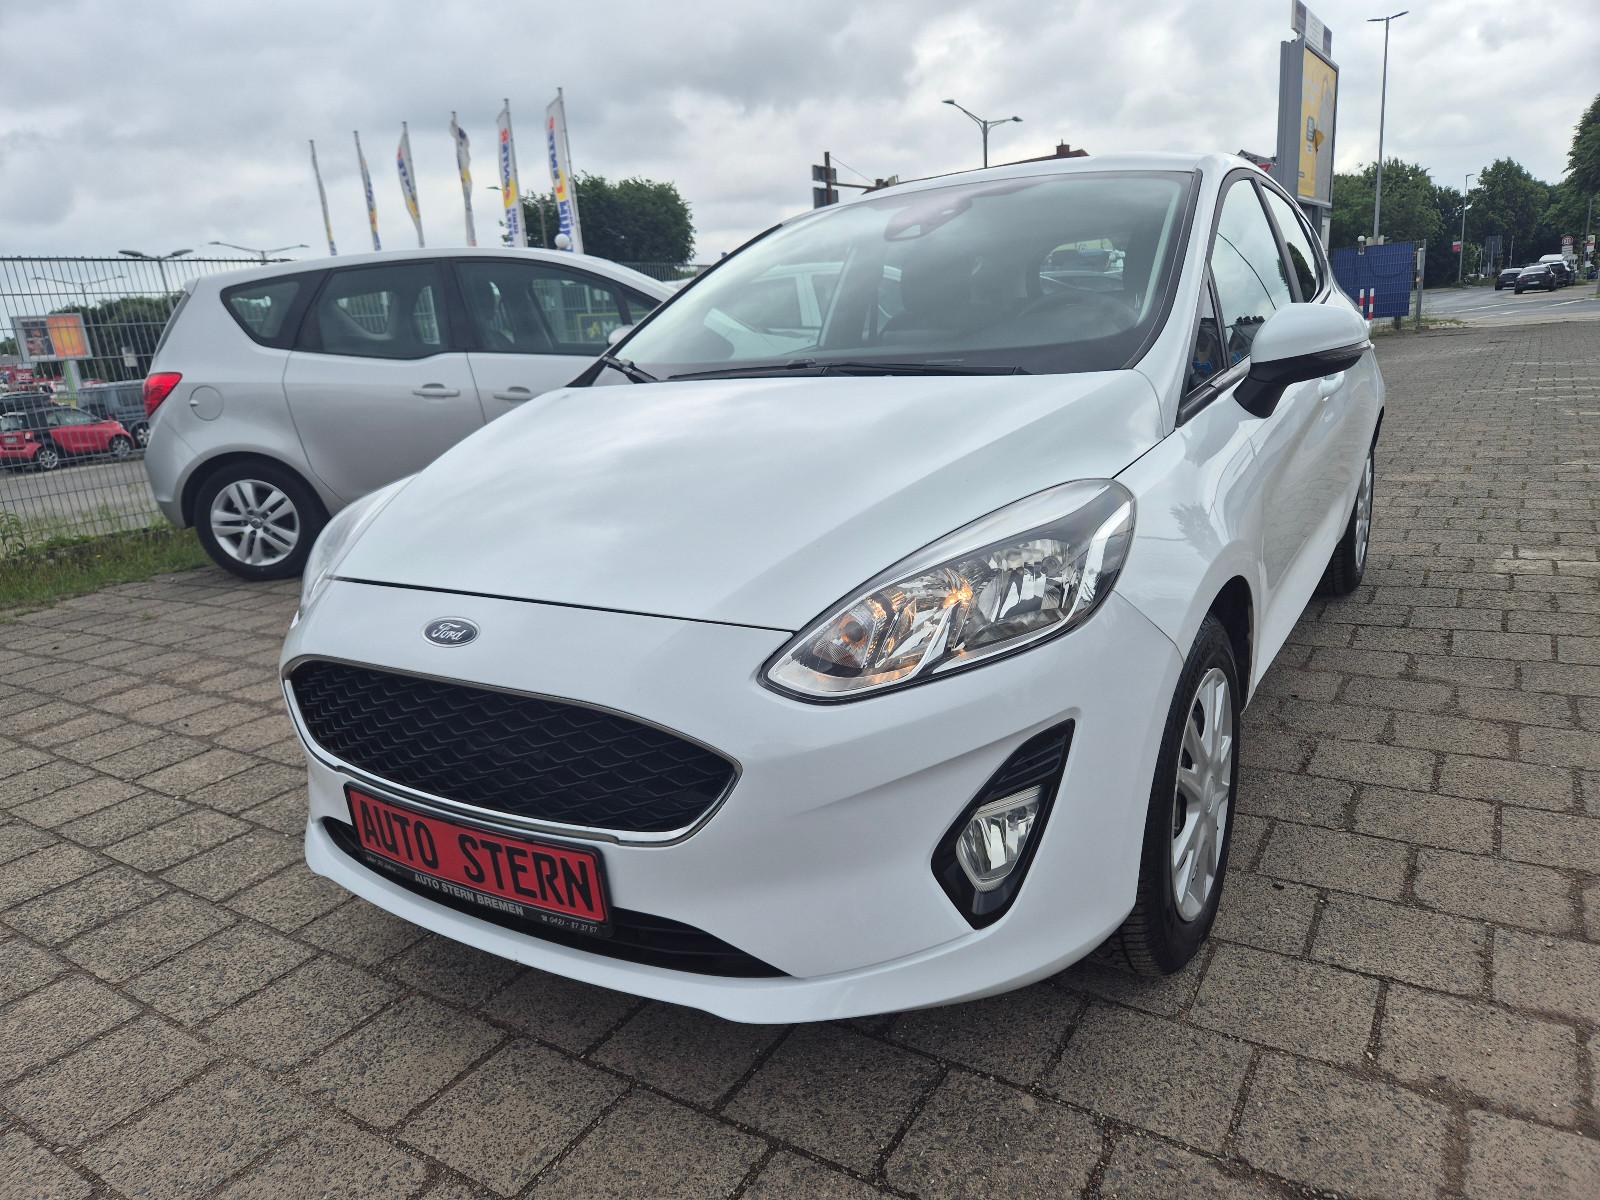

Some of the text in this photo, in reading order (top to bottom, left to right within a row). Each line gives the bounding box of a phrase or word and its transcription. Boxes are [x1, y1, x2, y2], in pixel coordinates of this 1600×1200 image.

[431, 622, 467, 640] Ford
[361, 800, 595, 913] AUTO STERN
[415, 873, 525, 916] AUTO STERN BREMEN
